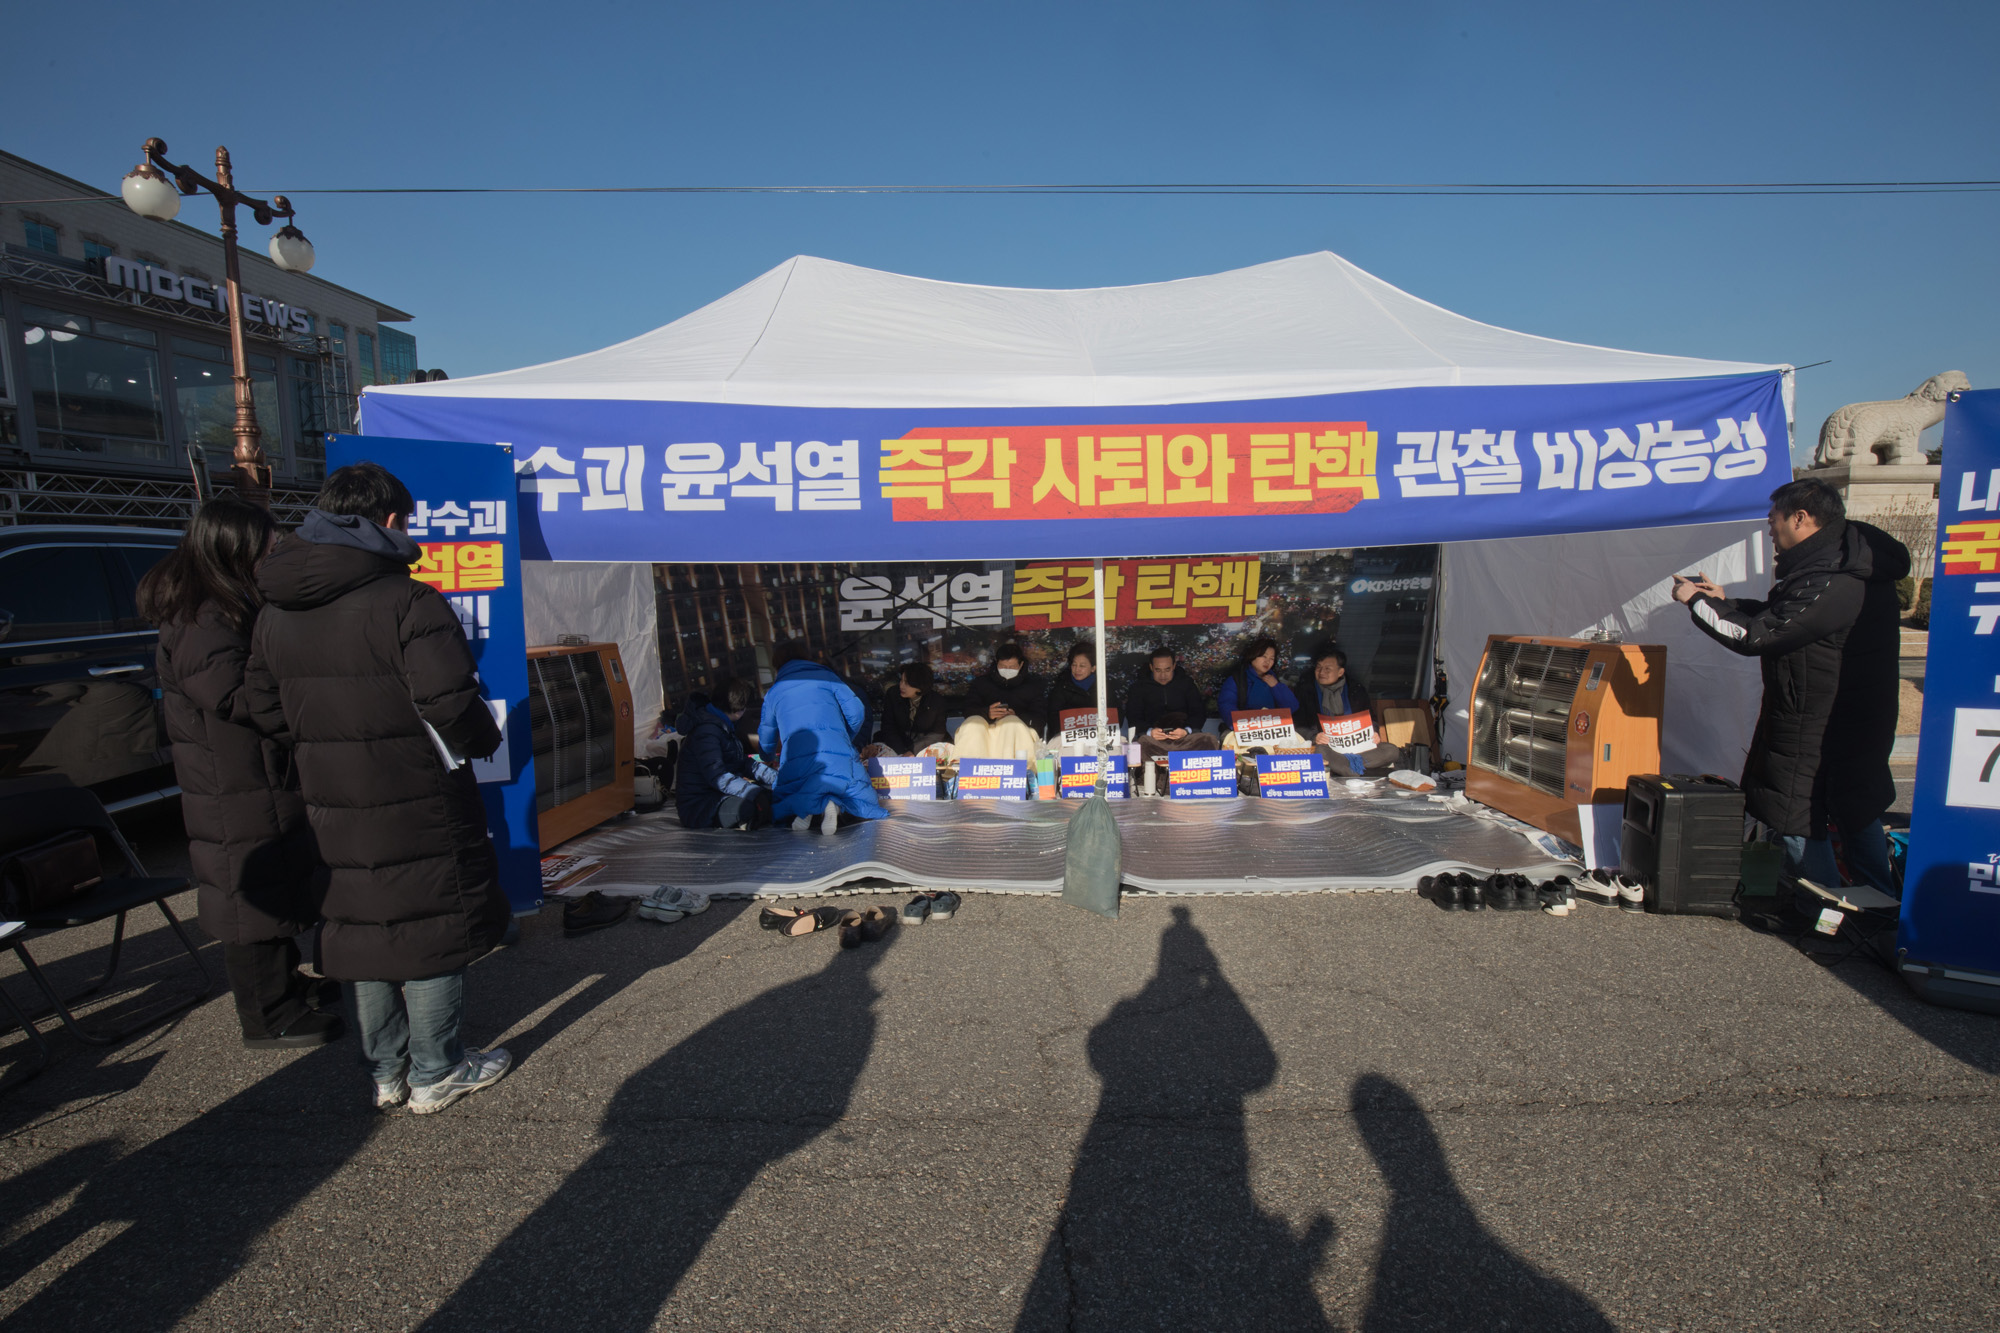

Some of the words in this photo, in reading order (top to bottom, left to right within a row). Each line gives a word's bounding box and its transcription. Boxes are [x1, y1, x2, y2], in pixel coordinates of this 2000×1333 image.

[514, 445, 645, 511] 수괴
[661, 440, 861, 511] 윤석열
[878, 438, 1017, 510] 즉각
[1033, 433, 1235, 506] 사퇴와
[1250, 430, 1380, 503] 탄핵
[1393, 428, 1522, 498] 관철
[1532, 412, 1767, 491] 비상농성
[840, 572, 1003, 632] 윤석열
[1012, 566, 1125, 624] 즉각
[1136, 560, 1261, 620] 탄핵!
[1064, 713, 1109, 730] 윤석열
[1240, 726, 1291, 743] 탄핵하라!
[882, 763, 923, 775] 내란공범
[1182, 756, 1222, 769] 내란공범
[1271, 759, 1311, 771] 내란공범
[973, 765, 1013, 776] 내란공범
[1170, 769, 1211, 784] 국민의힘
[959, 777, 1001, 789] 국민의힘
[1260, 771, 1301, 785] 국민의힘
